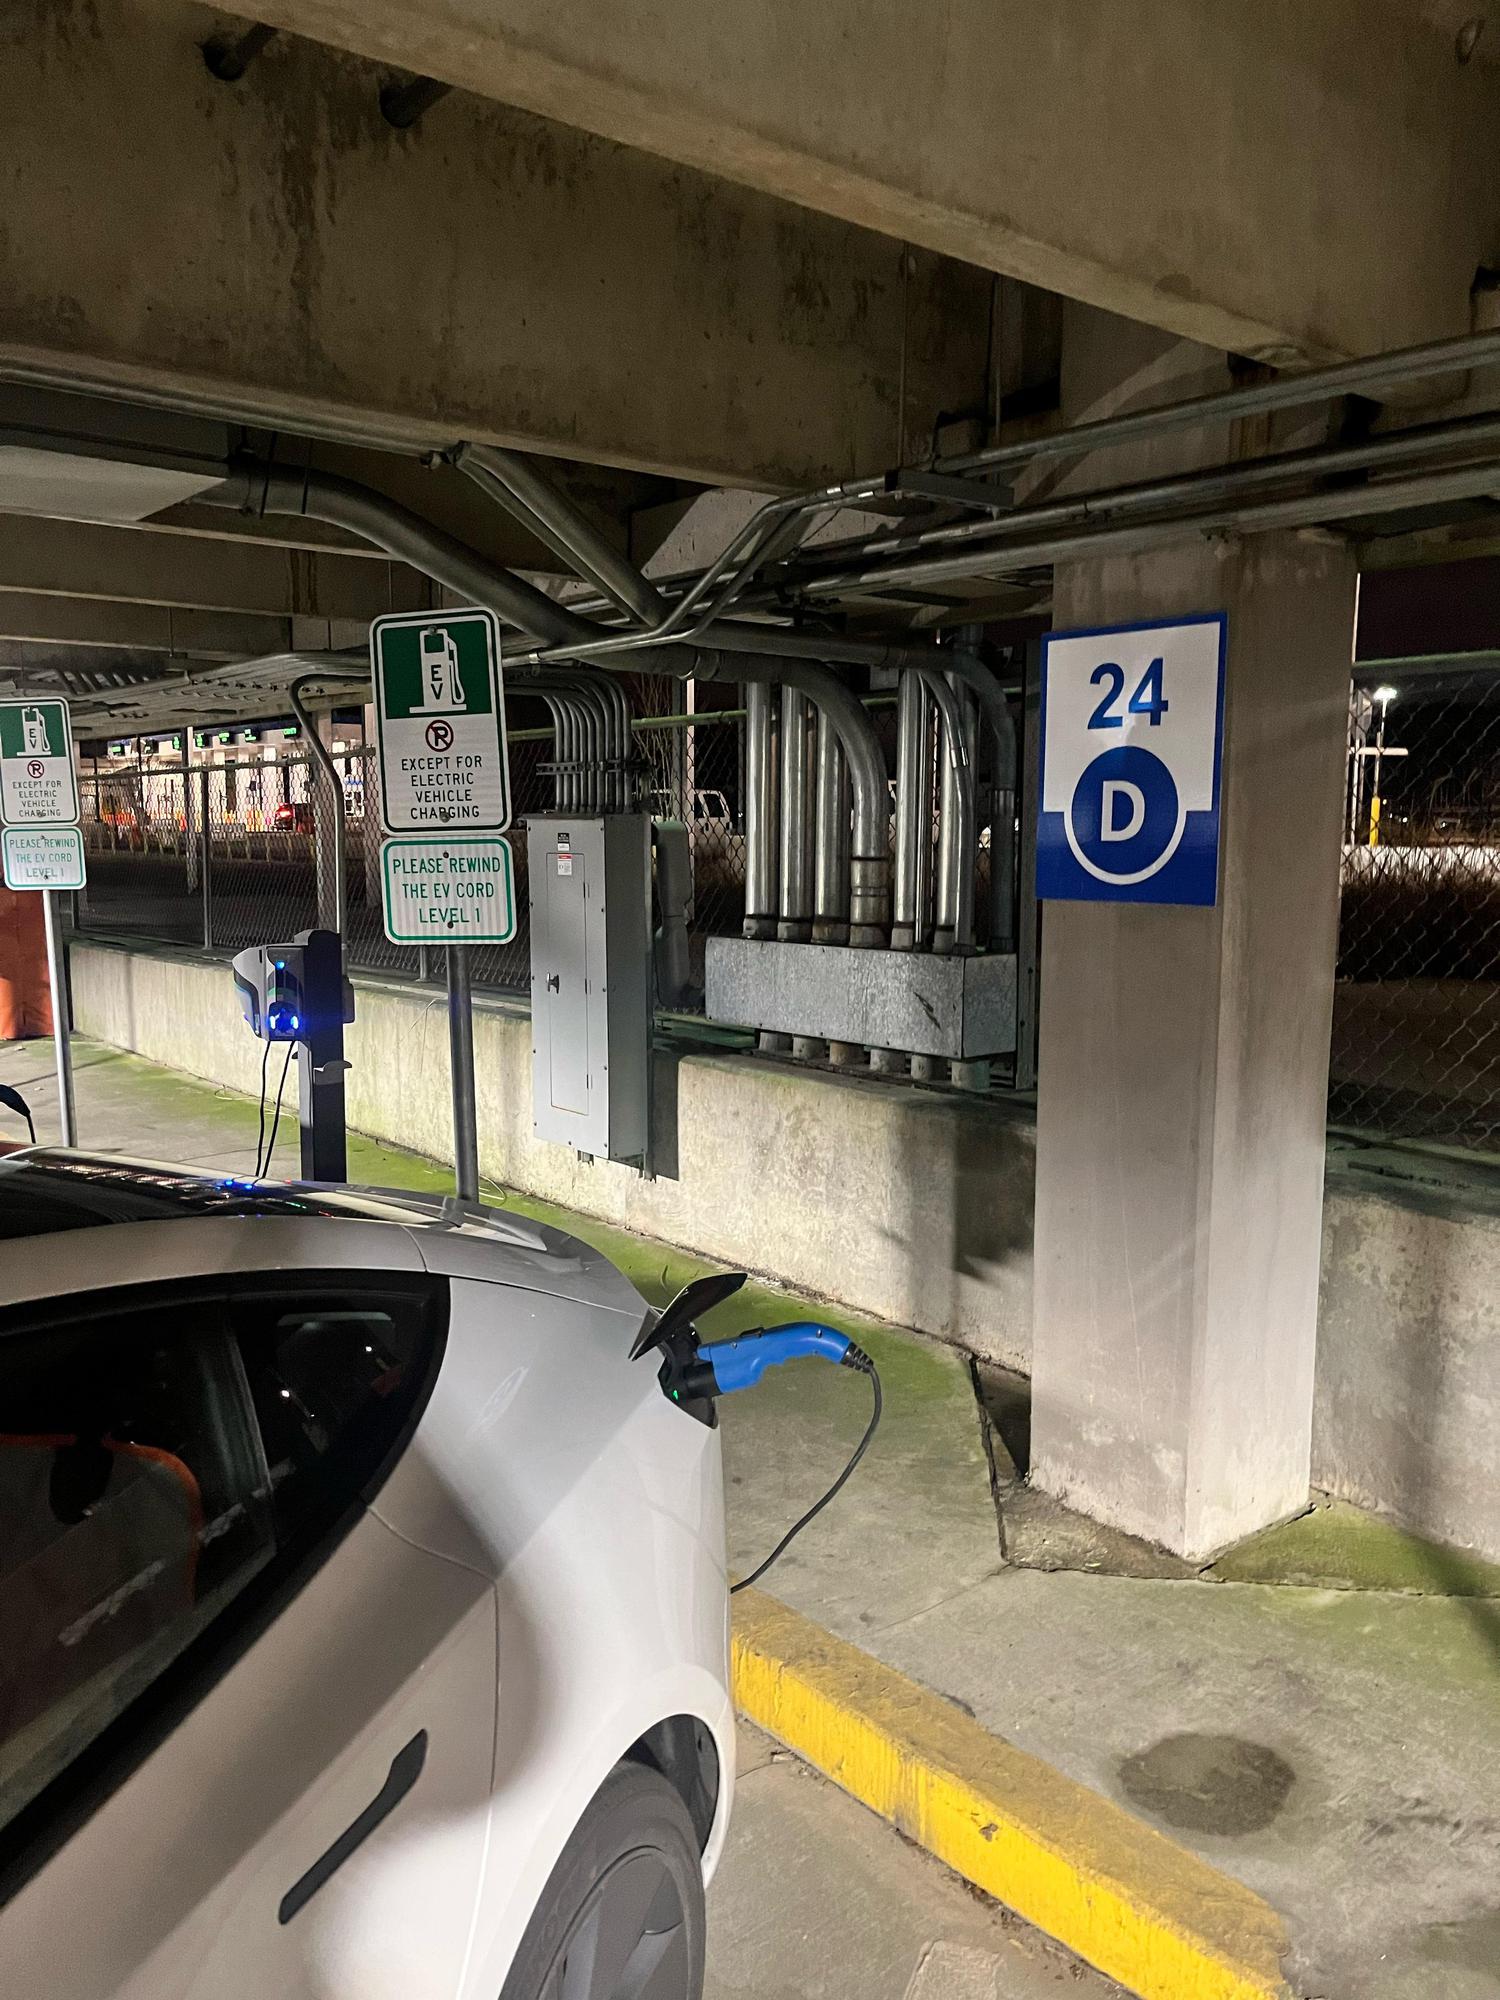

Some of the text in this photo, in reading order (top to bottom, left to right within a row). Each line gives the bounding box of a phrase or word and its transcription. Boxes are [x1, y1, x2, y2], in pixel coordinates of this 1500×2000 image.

[1087, 657, 1169, 730] 24
[401, 755, 482, 771] EXCEPT FOR
[12, 780, 62, 789] EXCEPT FOR
[411, 772, 474, 787] ELECTRIC
[18, 790, 57, 798] ELECTRIC
[415, 788, 473, 803] VEHICLE
[21, 799, 57, 807] VEHICLE
[1100, 780, 1145, 842] D
[9, 838, 76, 849] PLEASE REWIND
[16, 853, 72, 863] THE EV CORD
[392, 857, 501, 874] PLEASE REWIND
[26, 867, 58, 878] LEVEL
[402, 882, 495, 899] THE EV CORD
[418, 907, 481, 923] LEVEL 1
